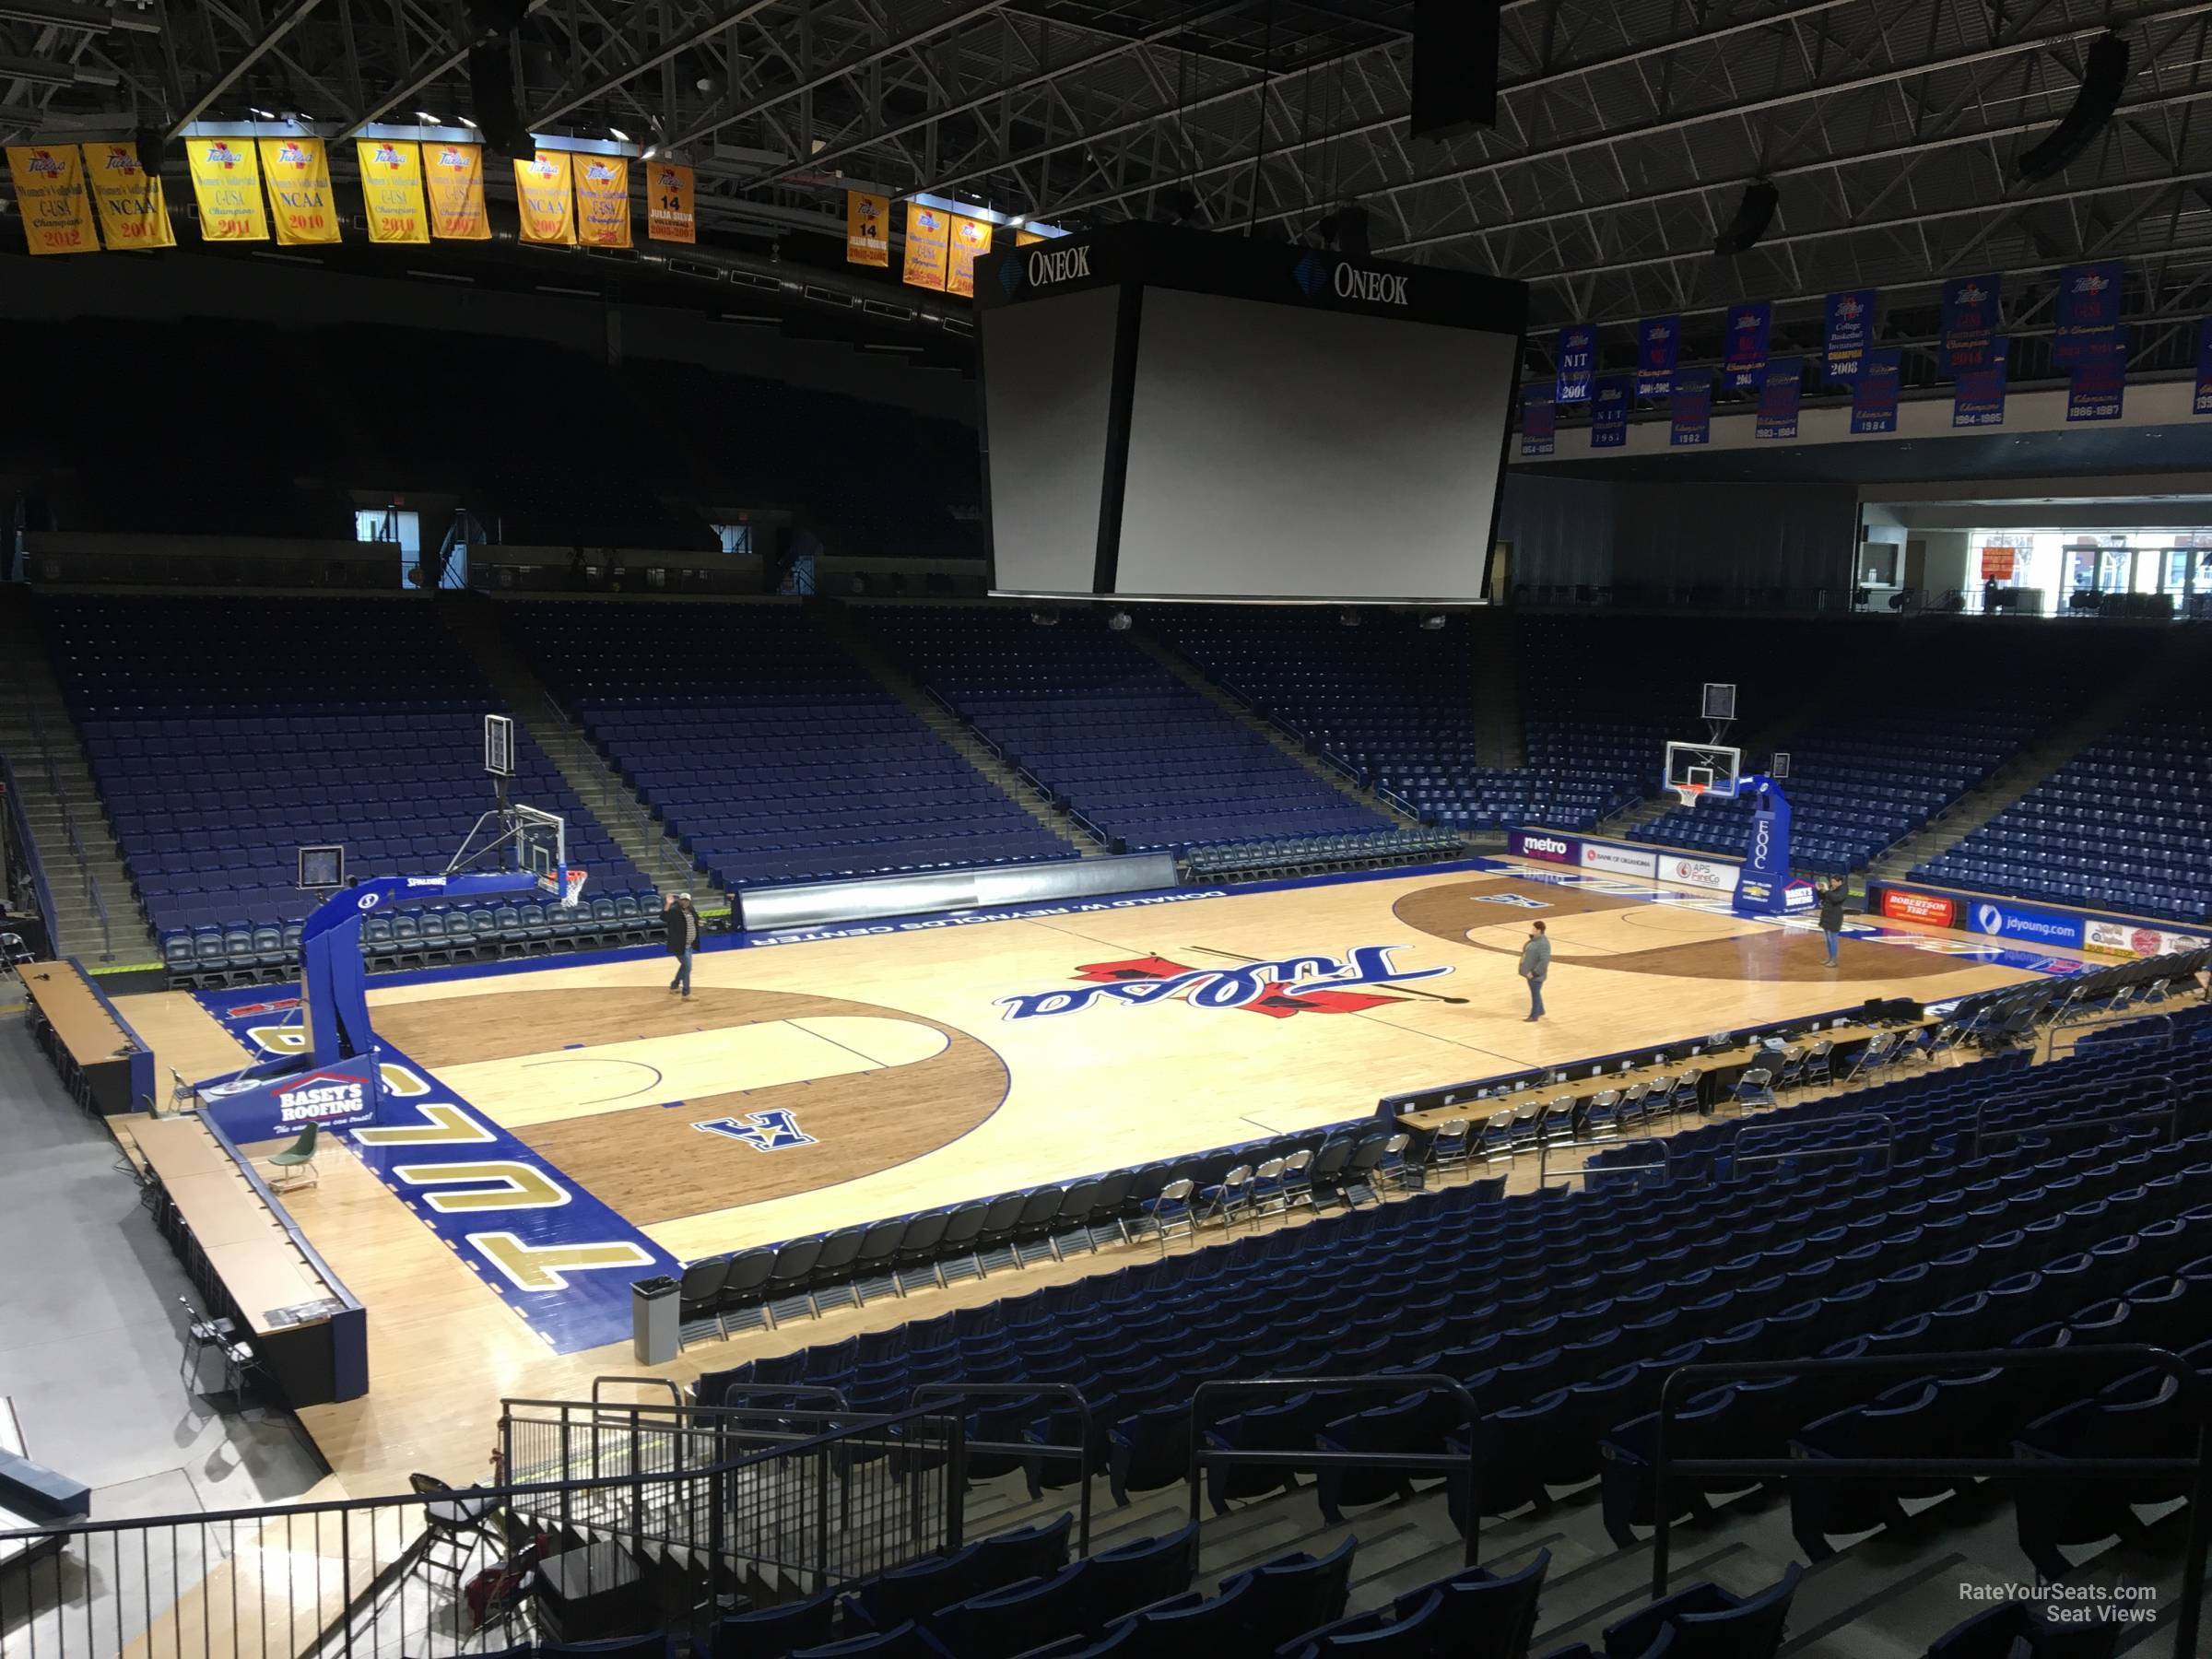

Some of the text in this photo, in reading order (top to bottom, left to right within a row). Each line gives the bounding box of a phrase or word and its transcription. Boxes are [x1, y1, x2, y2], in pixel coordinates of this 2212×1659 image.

[206, 149, 241, 162] Tulsa
[278, 149, 312, 162] Tulsa
[374, 150, 406, 163] Tulsa
[438, 152, 470, 166] Tulsa
[29, 159, 65, 172] Tulsa
[586, 167, 616, 178] Tulsa
[109, 199, 156, 215] NCAA
[280, 193, 324, 207] NCAA
[528, 199, 564, 214] NCAA
[661, 194, 679, 210] 14
[289, 215, 324, 229] 2010
[650, 209, 693, 222] JULIA SILVA
[121, 221, 156, 238] 2011
[218, 220, 250, 234] 2011
[382, 218, 414, 231] 2010
[860, 223, 877, 238] 14
[44, 229, 81, 246] 2012
[1029, 245, 1090, 288] ONEOK
[1335, 262, 1408, 305] ONEOK
[1563, 353, 1588, 368] NIT
[1830, 361, 1858, 376] 2008
[1562, 385, 1586, 398] 2001
[1861, 421, 1886, 430] 1984
[1524, 838, 1567, 853] metro
[1693, 863, 1710, 874] APS
[406, 877, 447, 887] SPALDING
[1691, 872, 1720, 884] FireCo
[1889, 896, 1947, 911] ROBERTSON
[1906, 906, 1929, 915] TIRE
[752, 889, 1228, 947] DONALD W. REYNOLDS CENTER
[2006, 916, 2075, 936] jdyoung.com
[993, 944, 1455, 1021] Tulsa
[279, 1083, 362, 1108] BASEY'S
[281, 1098, 363, 1122] ROOFING
